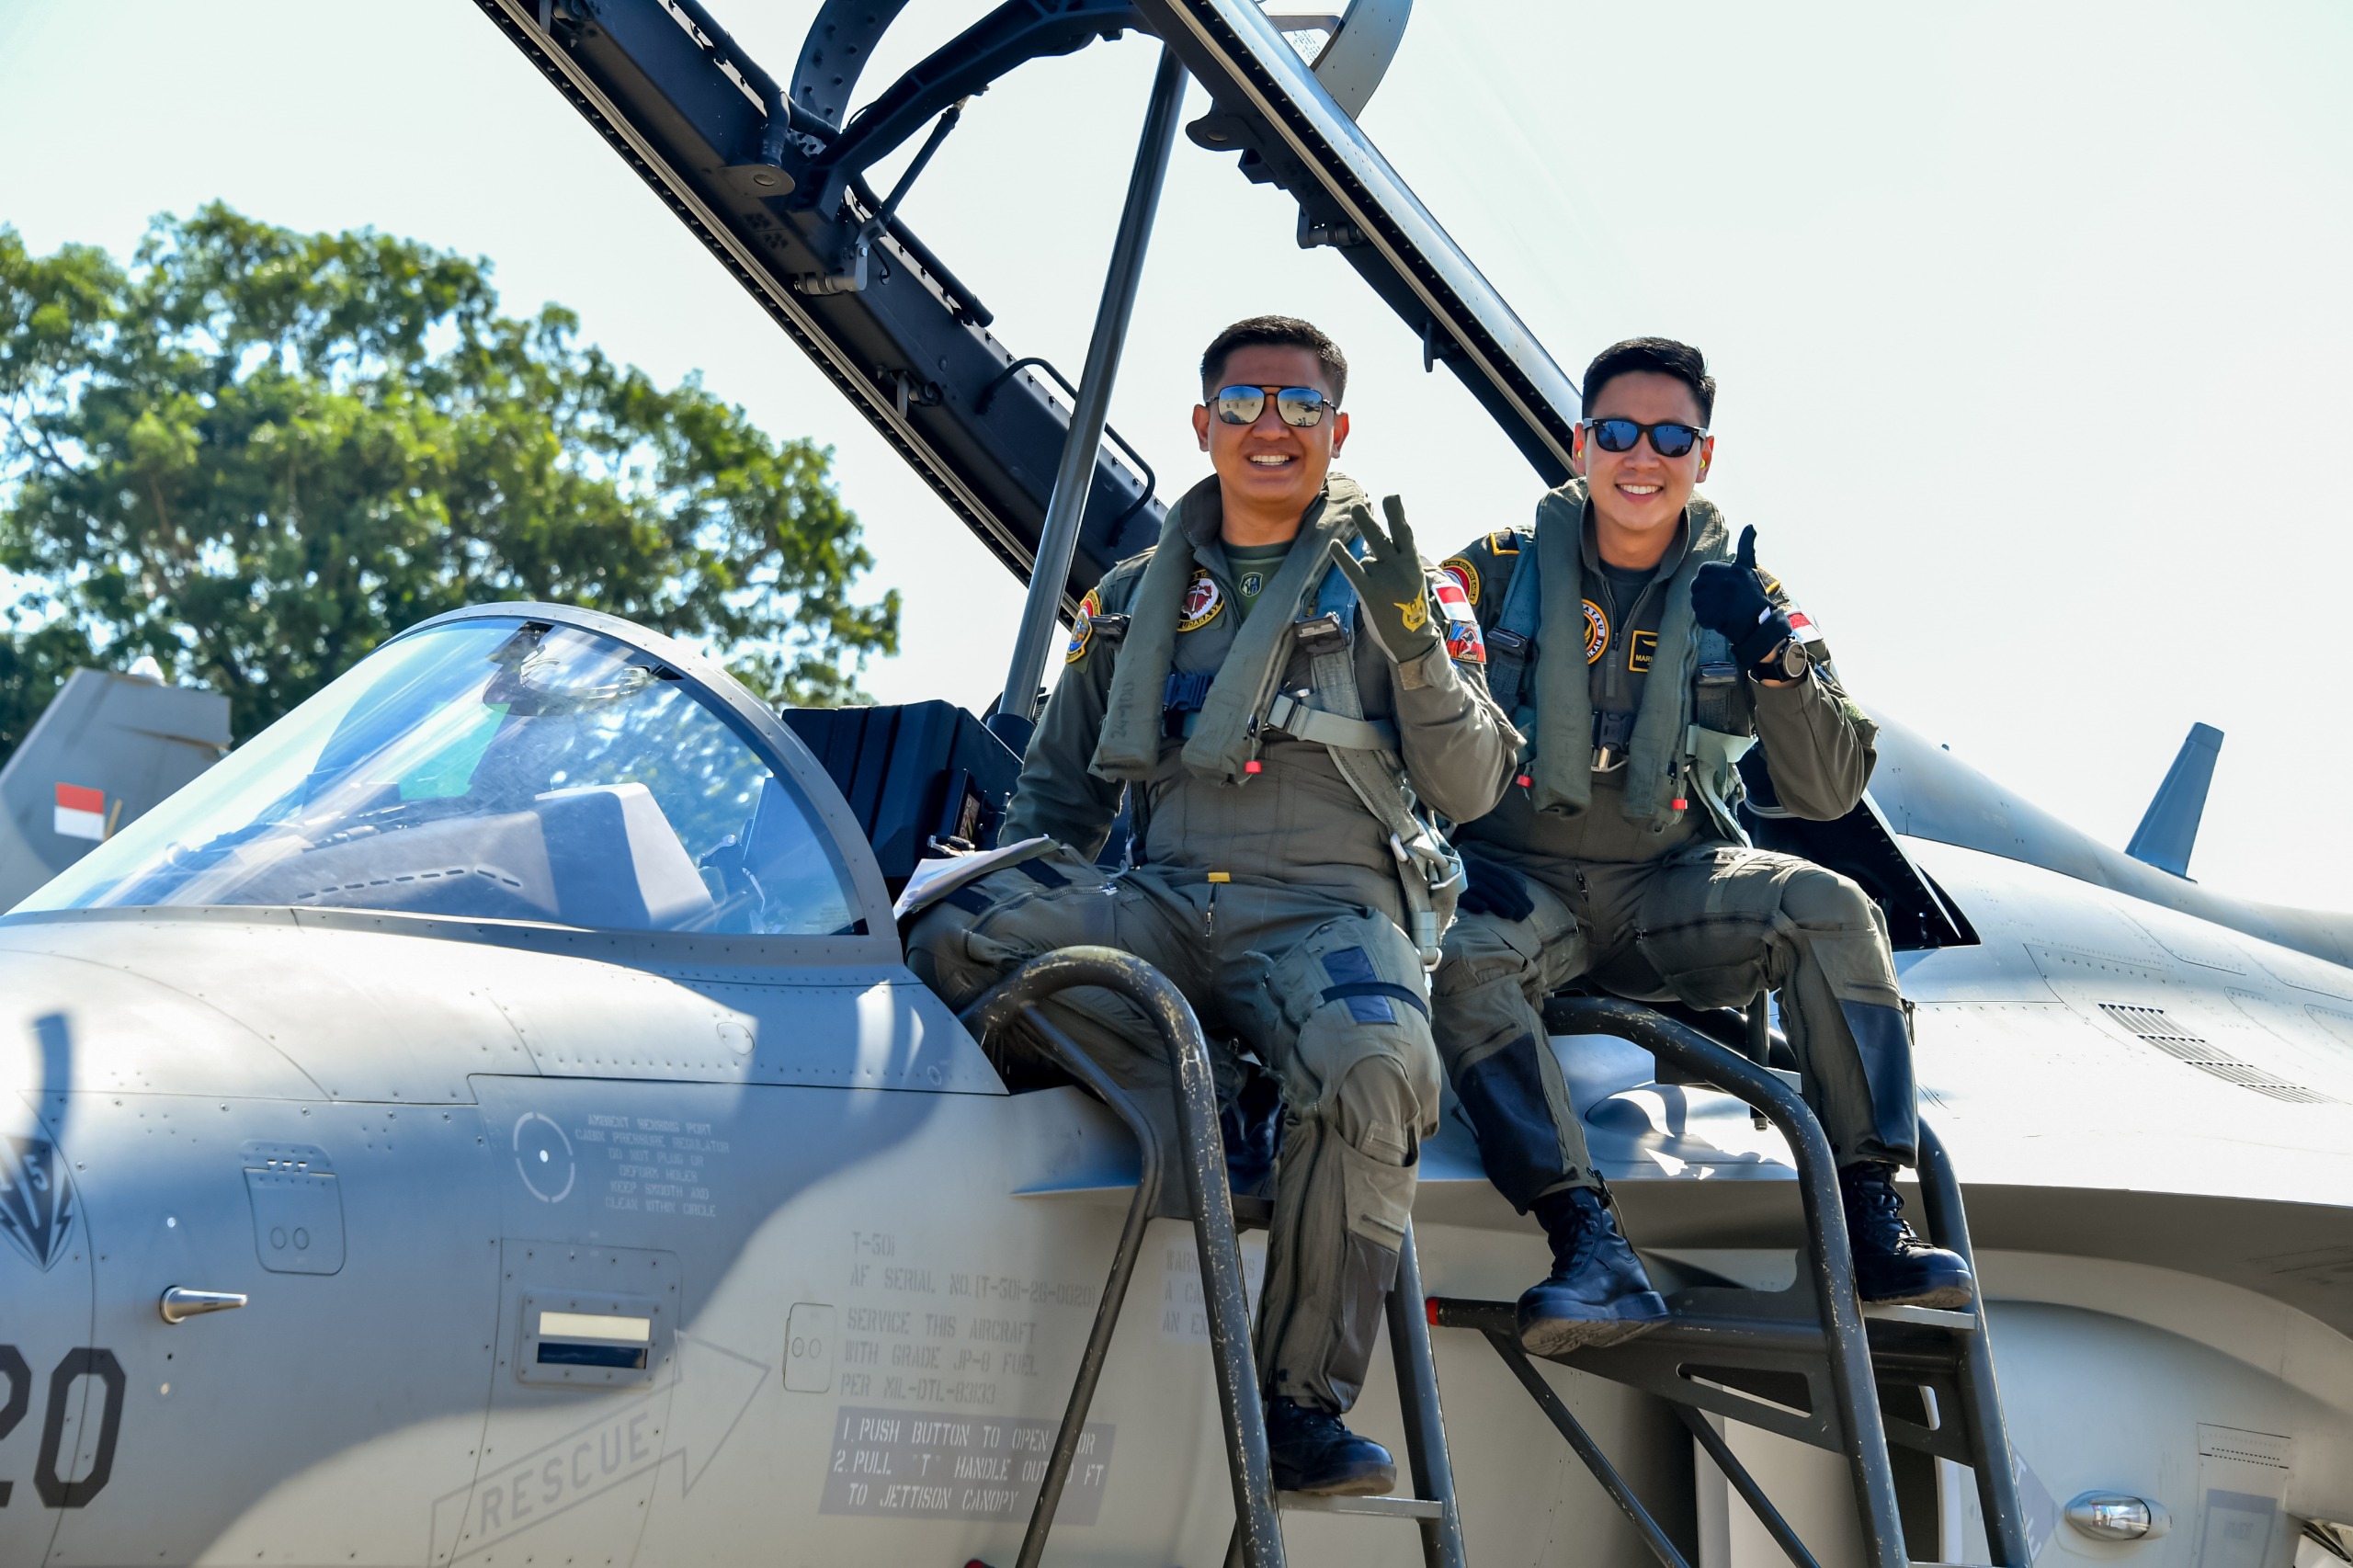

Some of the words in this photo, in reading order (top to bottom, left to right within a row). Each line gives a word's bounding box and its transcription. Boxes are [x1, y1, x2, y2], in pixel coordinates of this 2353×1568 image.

[1181, 615, 1211, 629] UDARA
[1582, 606, 1604, 630] ATAU
[1586, 639, 1603, 658] IKAN
[587, 1114, 629, 1129] AMBIENT
[686, 1121, 711, 1136] PORT
[611, 1131, 666, 1148] PRESSURE
[672, 1136, 730, 1153] REGULATOR
[608, 1146, 623, 1160] DO
[629, 1149, 649, 1163] NOT
[656, 1151, 684, 1165] PLUG
[690, 1153, 704, 1167] OR
[619, 1164, 659, 1179] DEFORM
[665, 1168, 699, 1183] HOLES
[609, 1179, 637, 1194] KEEP
[643, 1182, 684, 1199] SMOOTH
[690, 1187, 710, 1200] AND
[605, 1195, 639, 1211] CLEAN
[644, 1199, 676, 1213] WITHIN
[682, 1202, 717, 1218] CIRCLE
[850, 1262, 871, 1287] AF
[884, 1267, 936, 1295] SERIAL
[847, 1307, 911, 1335] SERVICE
[925, 1313, 957, 1338] THIS
[969, 1317, 1038, 1346] AIRCRAFT
[1162, 1310, 1180, 1334] AN
[845, 1340, 879, 1365] WITH
[892, 1344, 941, 1369] GRADE
[953, 1348, 992, 1374] JP-8
[1002, 1351, 1039, 1377] FUEL
[840, 1372, 871, 1398] PER
[912, 1420, 971, 1448] BUTTON
[983, 1425, 1001, 1449] TO
[1012, 1428, 1049, 1452] OPEN
[1077, 1432, 1096, 1456] OR
[480, 1411, 650, 1536] RESCUE
[955, 1455, 1013, 1482] HANDLE
[1084, 1463, 1105, 1486] FT
[848, 1482, 869, 1507] TO
[880, 1483, 953, 1510] JETTISON
[961, 1487, 1020, 1514] CANOPY
